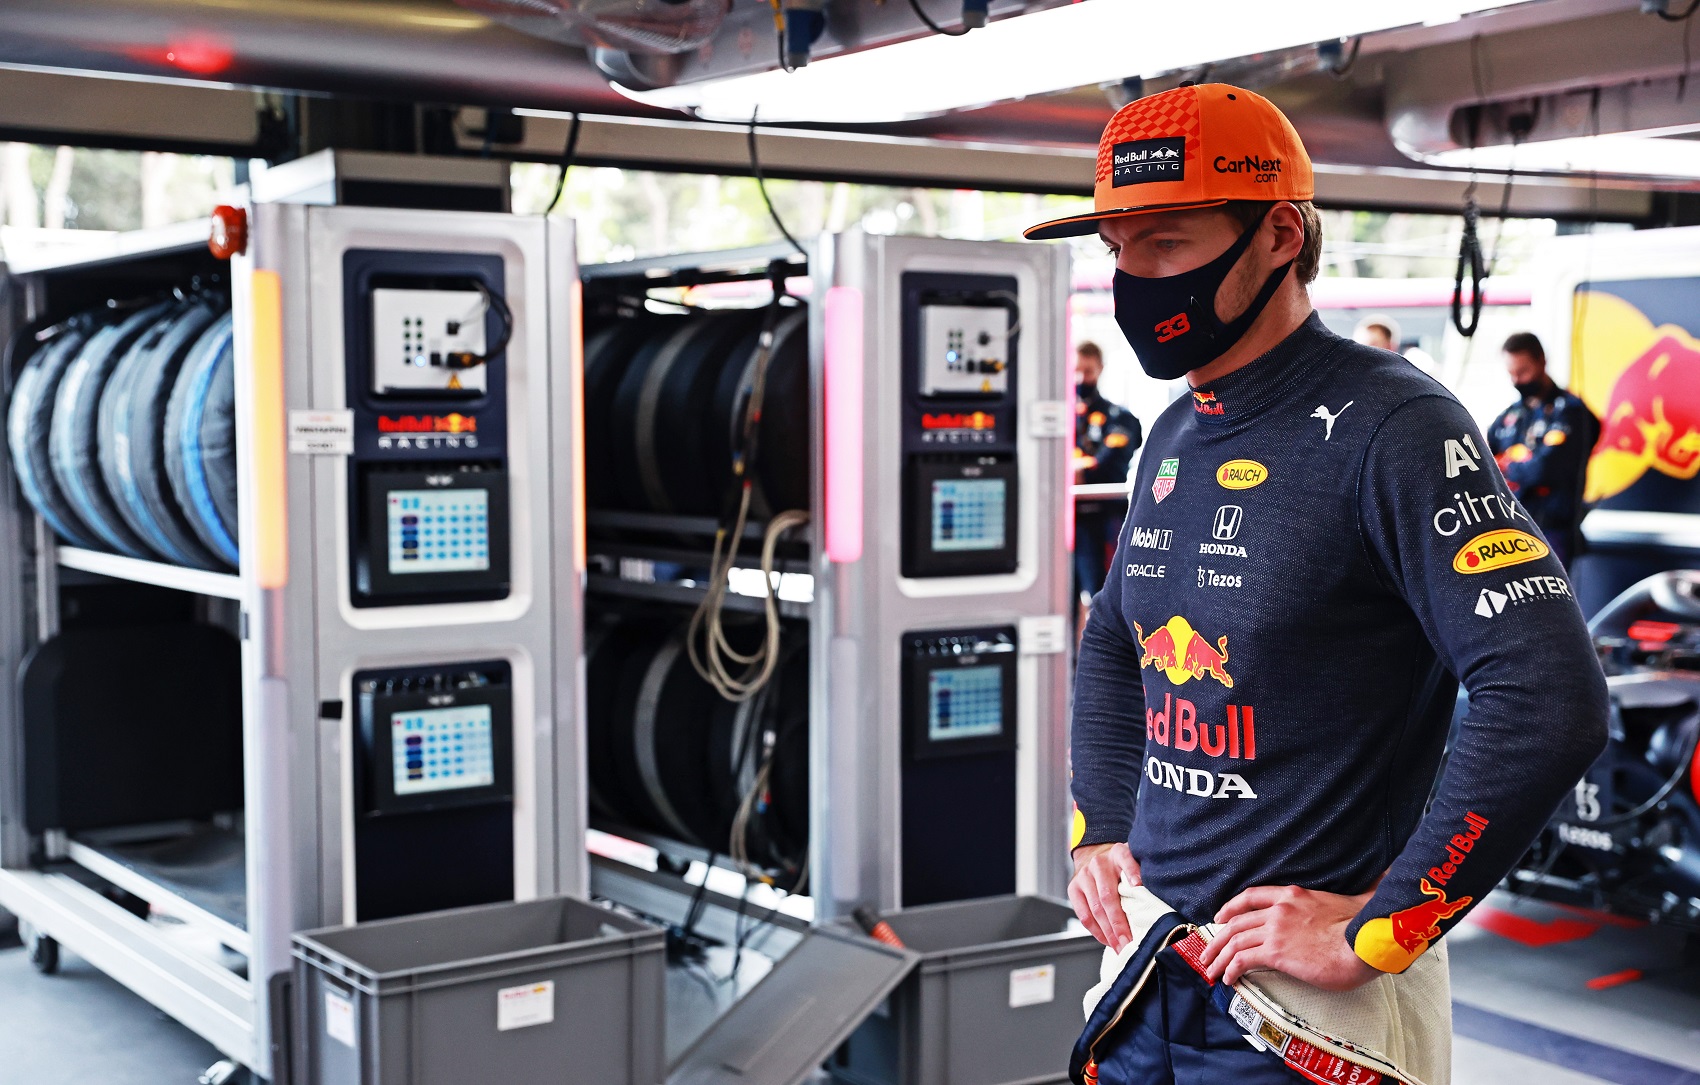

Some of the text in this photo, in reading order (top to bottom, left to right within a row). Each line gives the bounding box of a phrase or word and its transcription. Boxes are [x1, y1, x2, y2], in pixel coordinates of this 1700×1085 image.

[1114, 150, 1148, 165] Red Bull
[1213, 155, 1282, 173] CarNext
[1114, 163, 1180, 176] RACING
[1253, 172, 1278, 184] .com
[1155, 312, 1191, 343] 33
[378, 435, 479, 450] RACING
[1444, 433, 1481, 478] A1
[1160, 461, 1178, 476] TAG
[1228, 468, 1262, 482] RAUCH
[1433, 491, 1529, 536] citrix
[1130, 527, 1160, 549] Mobil
[1199, 543, 1247, 558] HONDA
[1478, 538, 1540, 561] RAUCH
[1126, 564, 1166, 578] ORACLE
[1208, 569, 1242, 588] Tezos
[1505, 575, 1572, 601] INTER
[1143, 684, 1256, 760] ed Bull
[1144, 752, 1258, 799] ONDA
[1428, 811, 1490, 886] Red Bull
